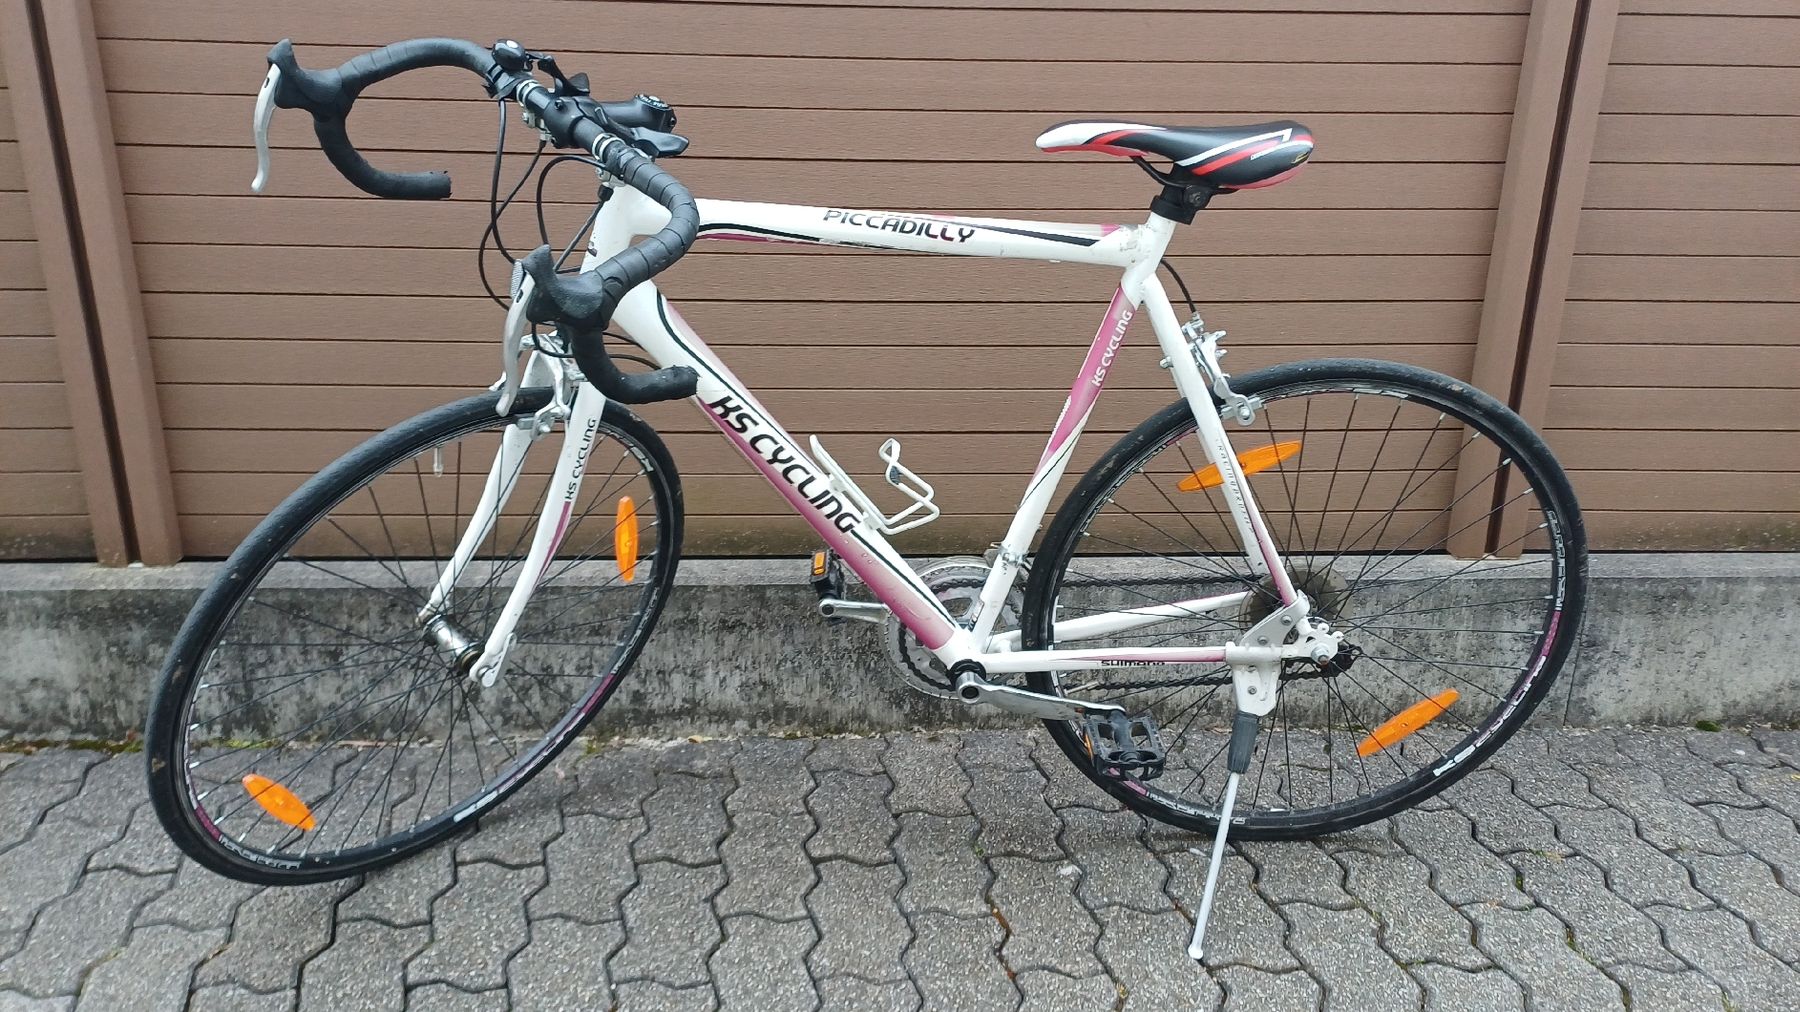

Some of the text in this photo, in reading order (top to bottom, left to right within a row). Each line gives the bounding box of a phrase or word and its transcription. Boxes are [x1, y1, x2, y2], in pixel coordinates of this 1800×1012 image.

[823, 209, 975, 243] PICCADILLY
[1091, 310, 1133, 387] KS CYCLING
[565, 418, 597, 500] KS CYCLING
[706, 395, 861, 534] KS CYCLING
